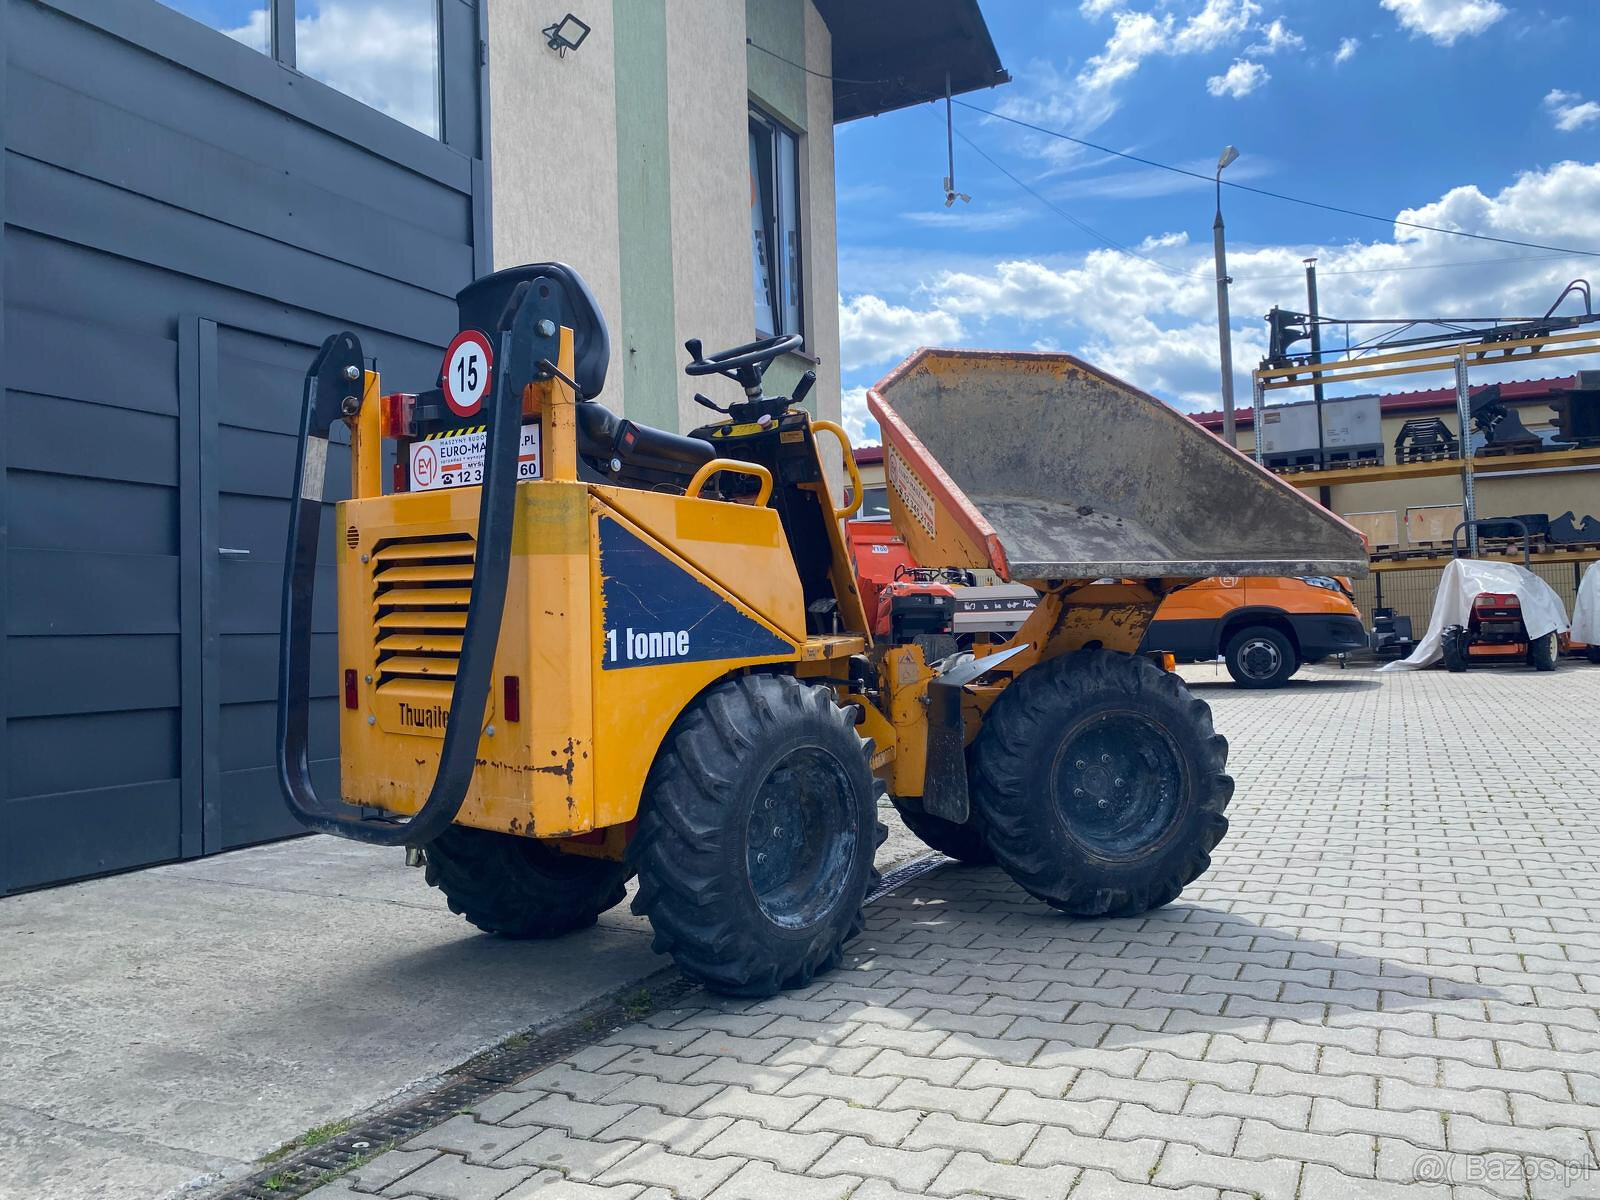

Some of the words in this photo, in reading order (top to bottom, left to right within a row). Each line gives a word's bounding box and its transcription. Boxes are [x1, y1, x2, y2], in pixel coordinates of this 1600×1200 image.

[457, 355, 478, 392] 15
[468, 434, 487, 442] BUDO
[458, 471, 471, 483] 12
[475, 469, 482, 481] 3
[520, 463, 536, 476] 60
[606, 629, 618, 662] 1
[626, 628, 690, 660] tonne
